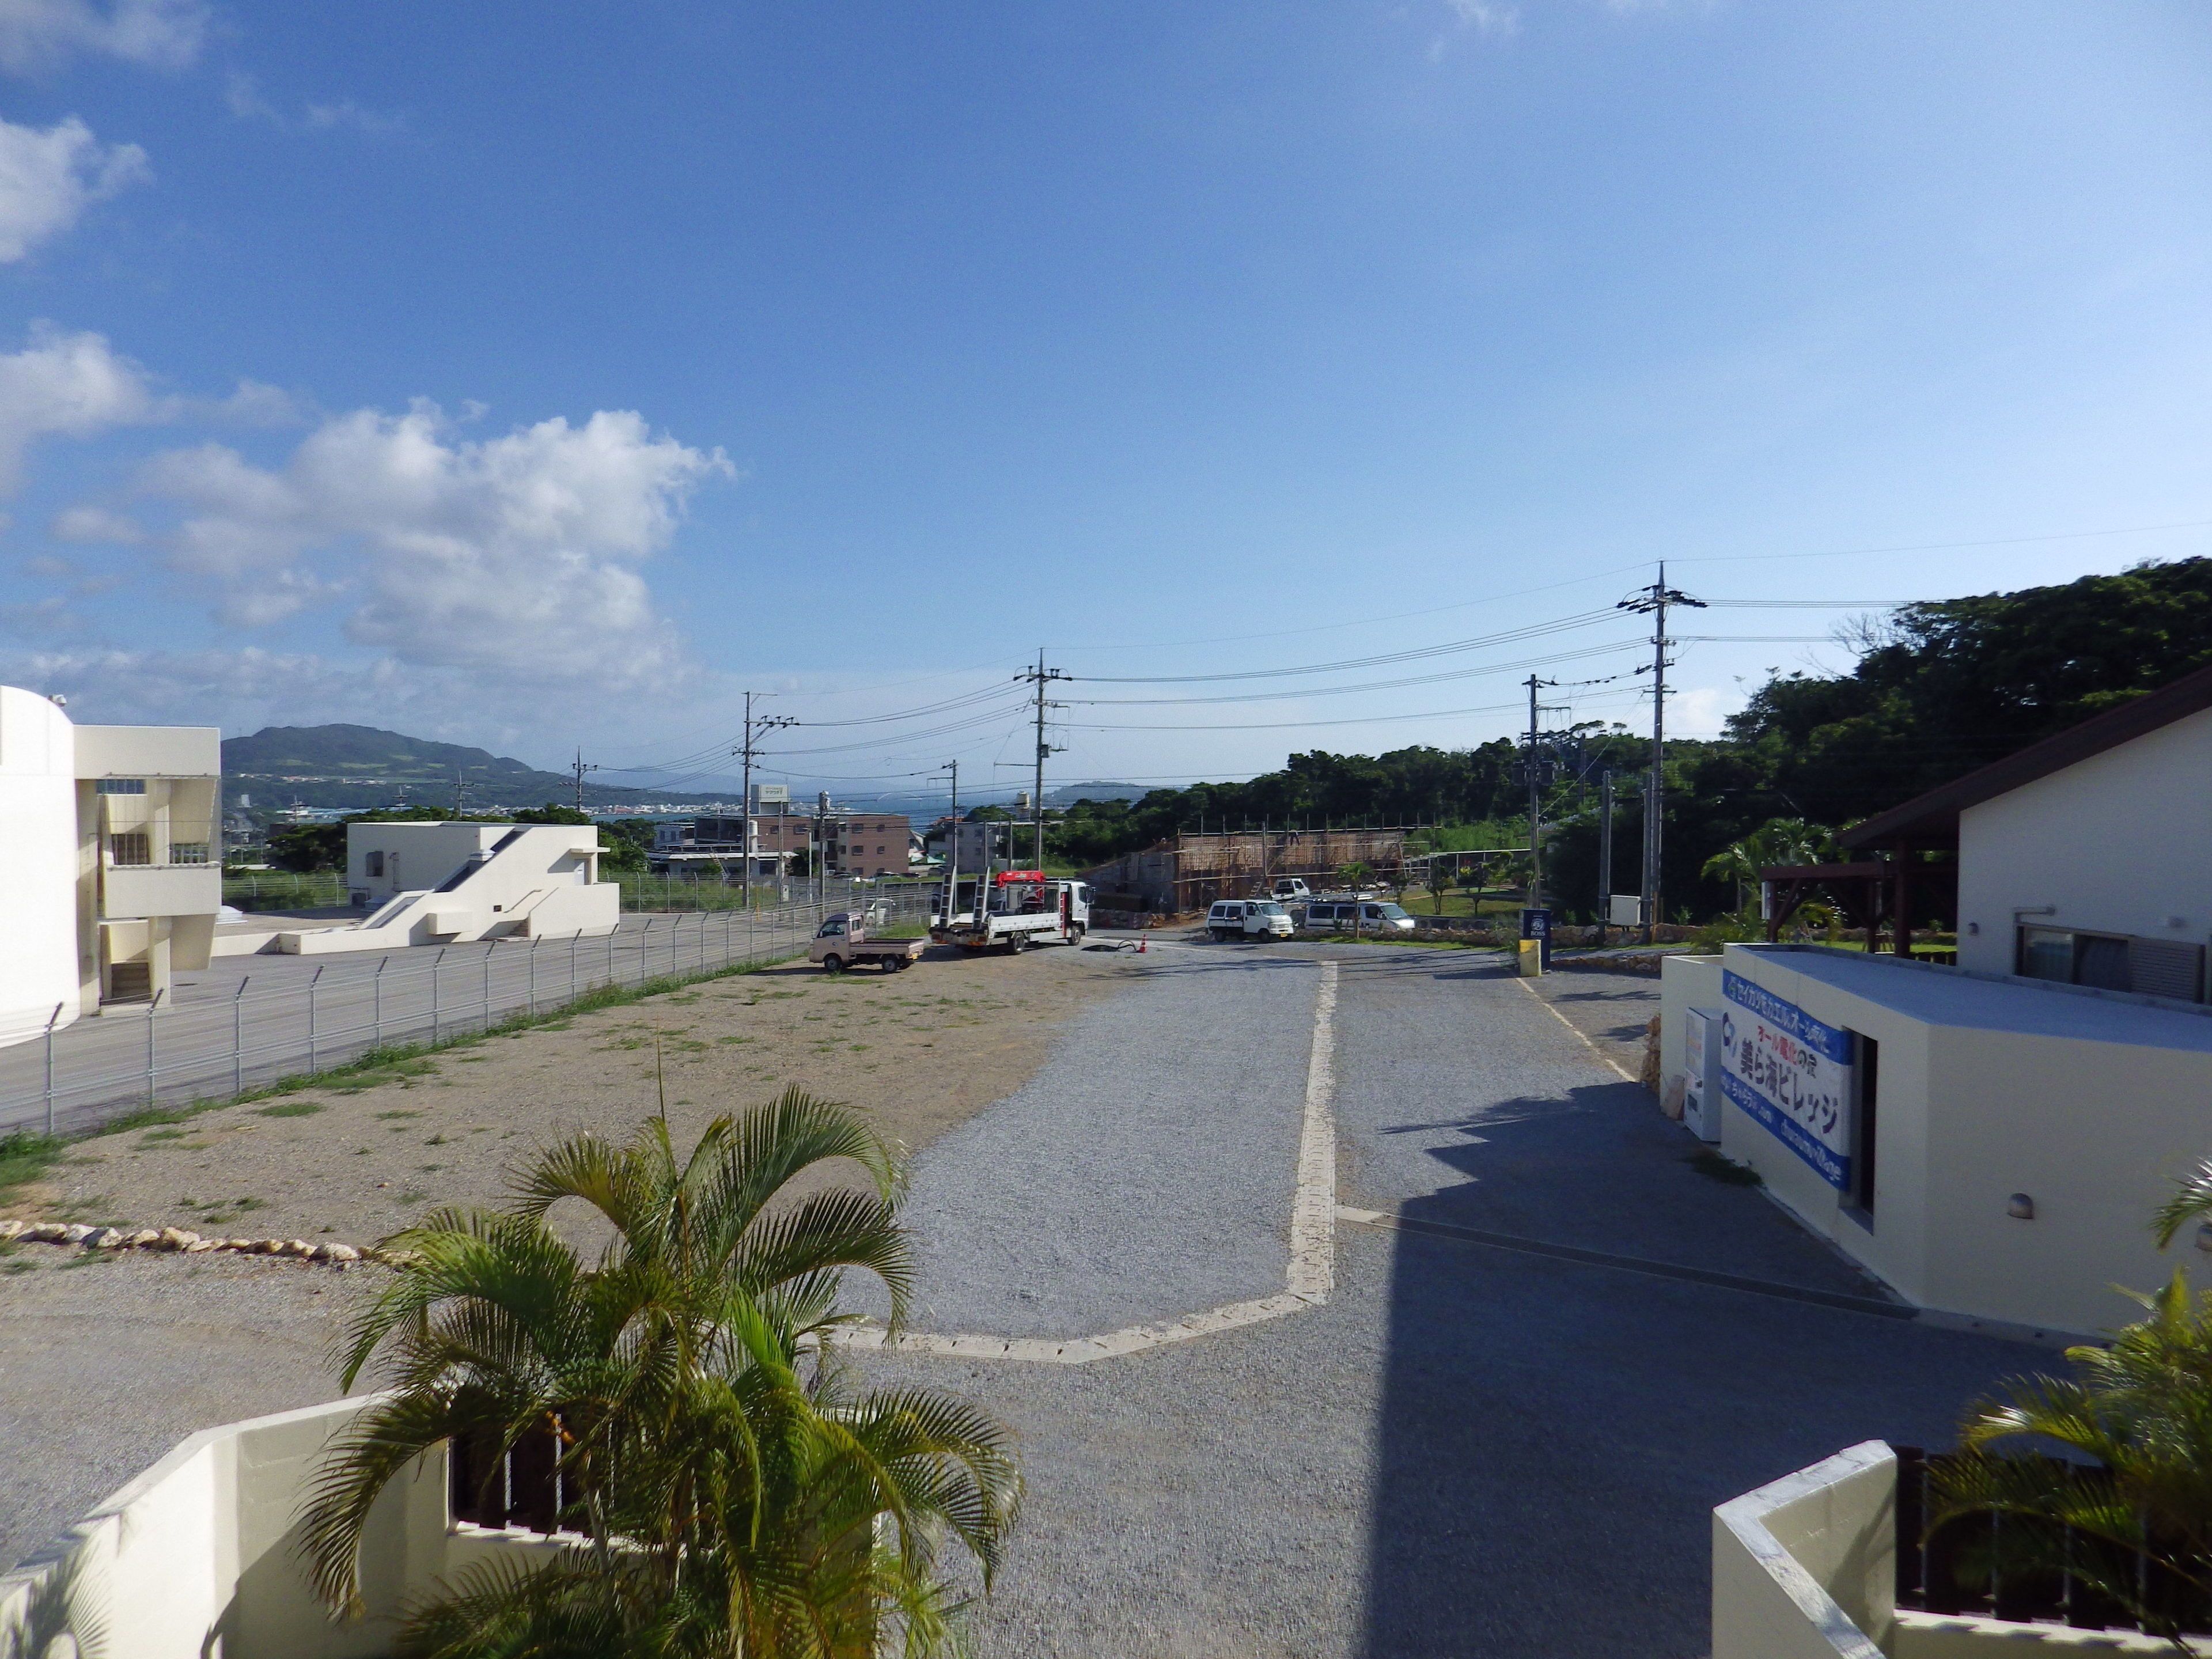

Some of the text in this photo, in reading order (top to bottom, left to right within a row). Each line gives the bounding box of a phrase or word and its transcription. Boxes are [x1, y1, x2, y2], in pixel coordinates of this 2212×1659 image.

[1740, 1037, 1838, 1134] 美ら海ビレッジ
